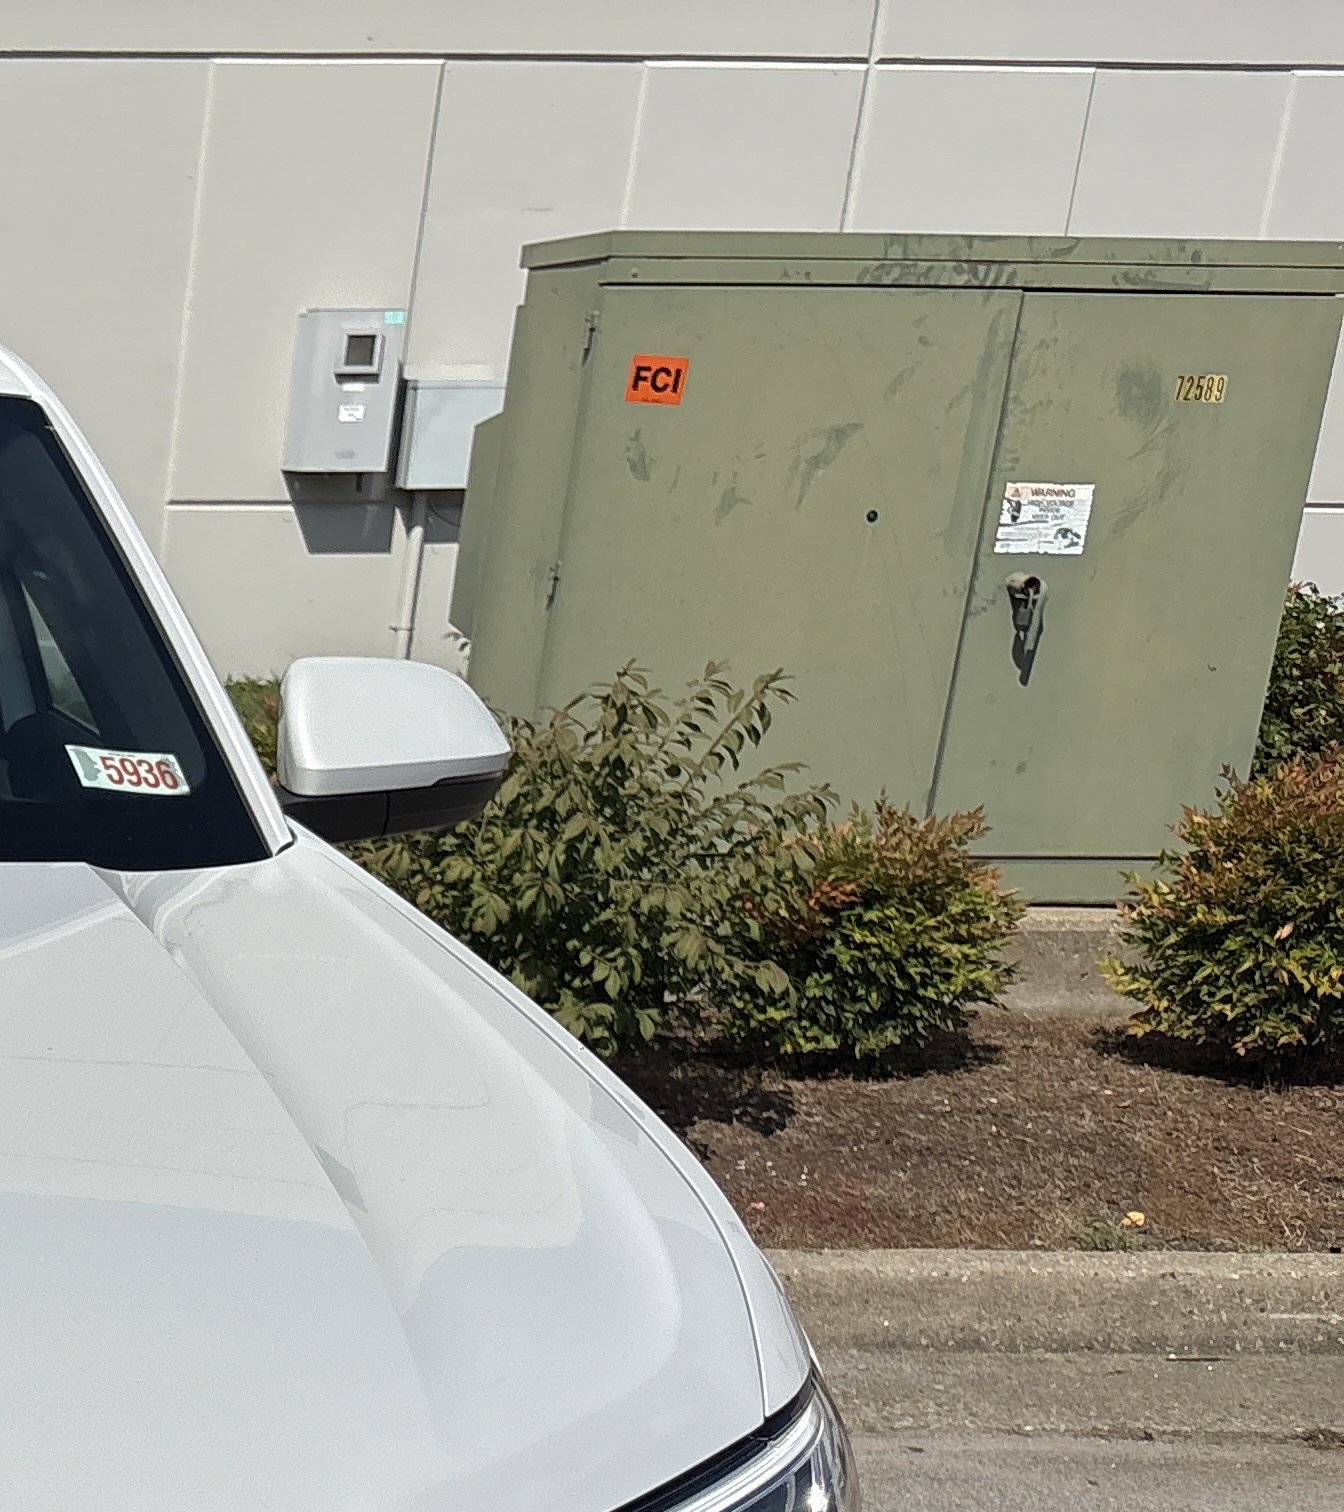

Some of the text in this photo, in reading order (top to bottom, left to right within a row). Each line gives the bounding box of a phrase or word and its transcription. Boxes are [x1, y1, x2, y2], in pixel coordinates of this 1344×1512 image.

[632, 366, 682, 394] FCI
[1176, 375, 1225, 402] 72589
[1031, 487, 1076, 498] WARNING
[99, 755, 179, 790] 5936
